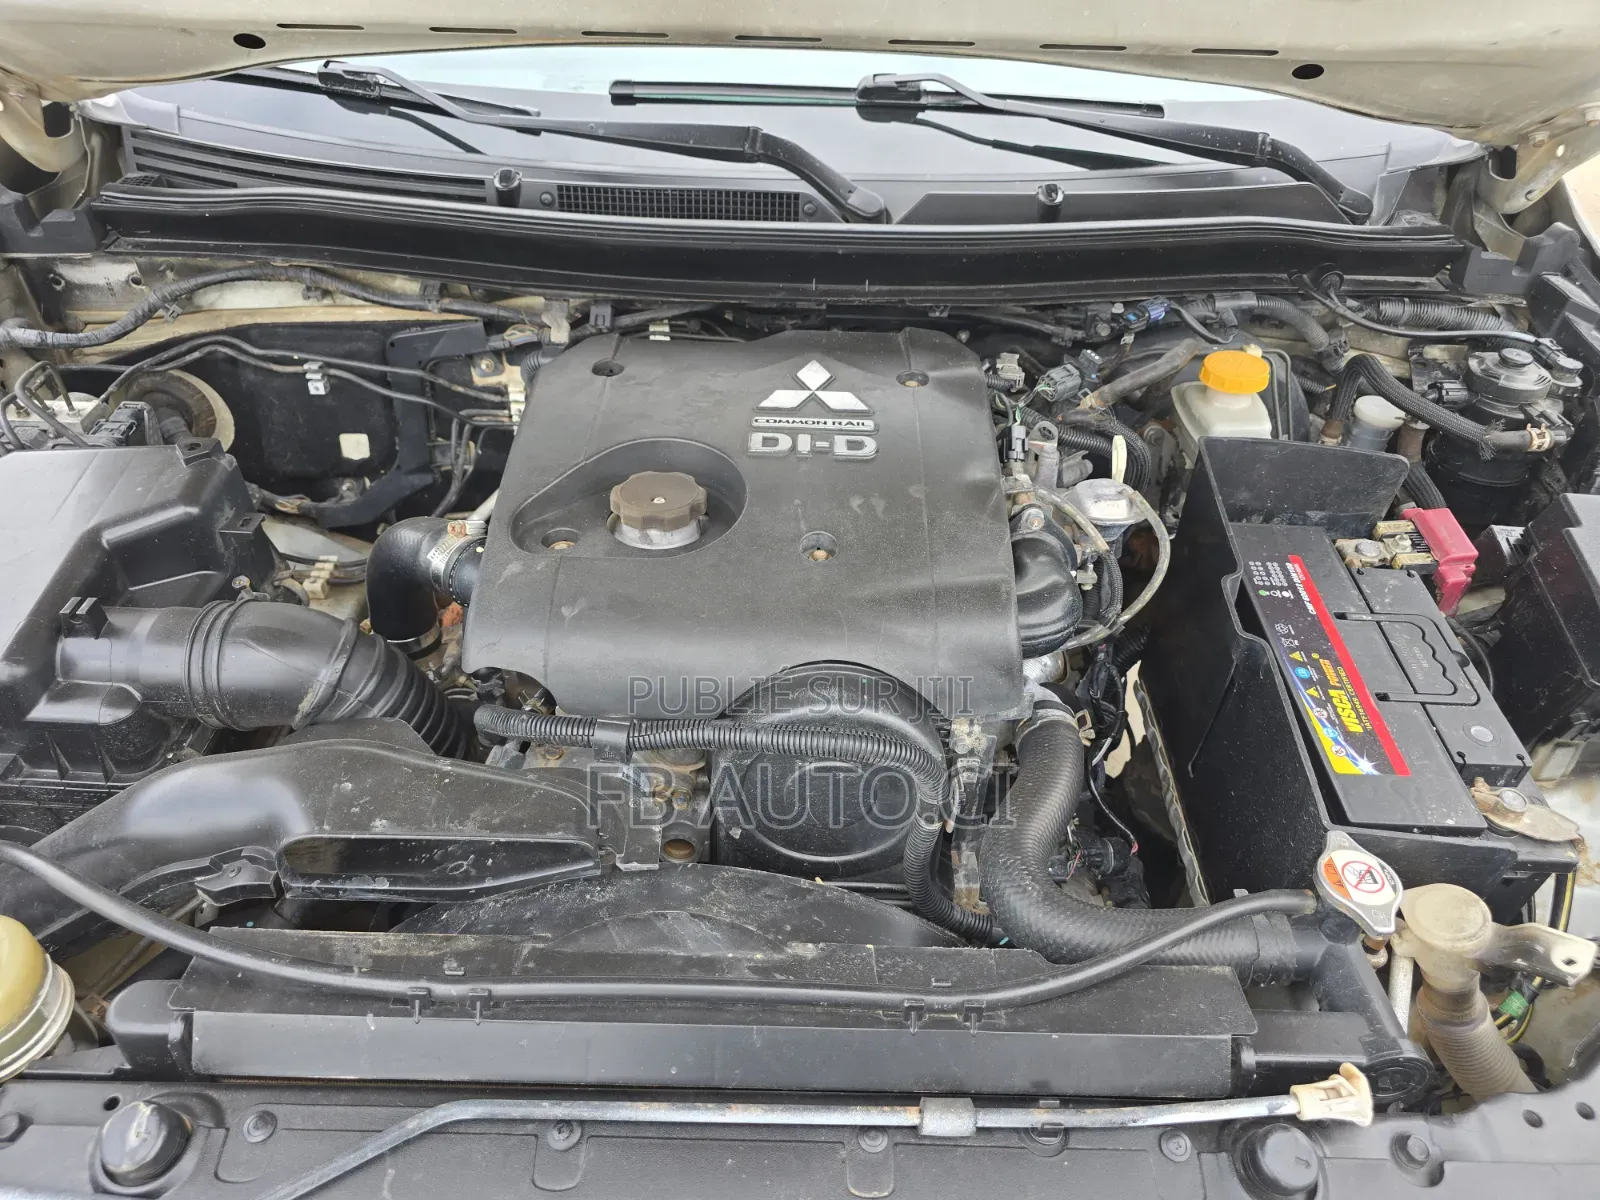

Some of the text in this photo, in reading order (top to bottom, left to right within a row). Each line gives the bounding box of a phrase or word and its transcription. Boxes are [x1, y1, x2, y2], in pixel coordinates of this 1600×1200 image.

[749, 432, 878, 457] DI-D
[1337, 666, 1356, 696] CERTIFIED
[1328, 689, 1364, 733] VISCA
